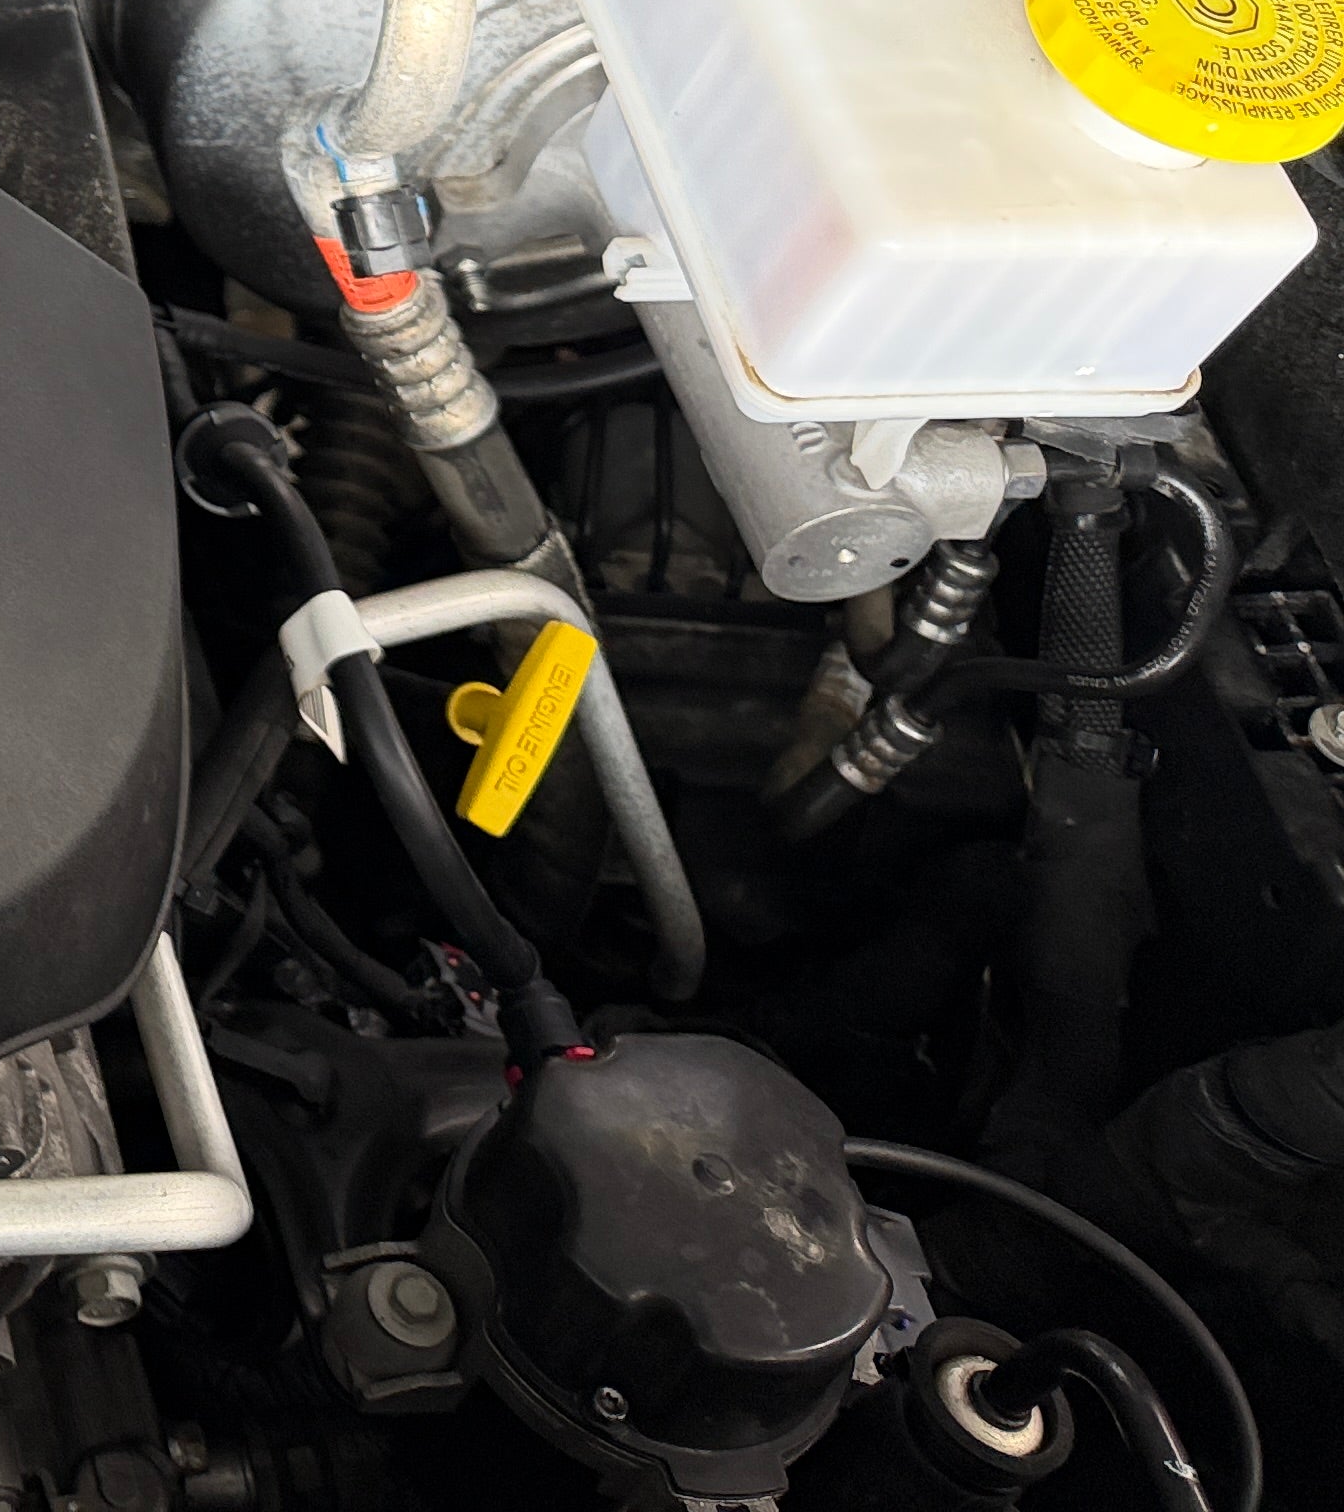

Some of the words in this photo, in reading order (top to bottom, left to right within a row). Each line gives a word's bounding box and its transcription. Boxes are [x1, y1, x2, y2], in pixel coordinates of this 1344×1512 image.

[1118, 0, 1149, 26] CAP
[1294, 2, 1319, 31] DOT
[1113, 22, 1155, 55] ONLY
[1190, 73, 1303, 101] UNIQUEMENT
[1293, 101, 1320, 119] DE
[517, 663, 576, 757] ENGINE
[494, 753, 527, 793] OIL
